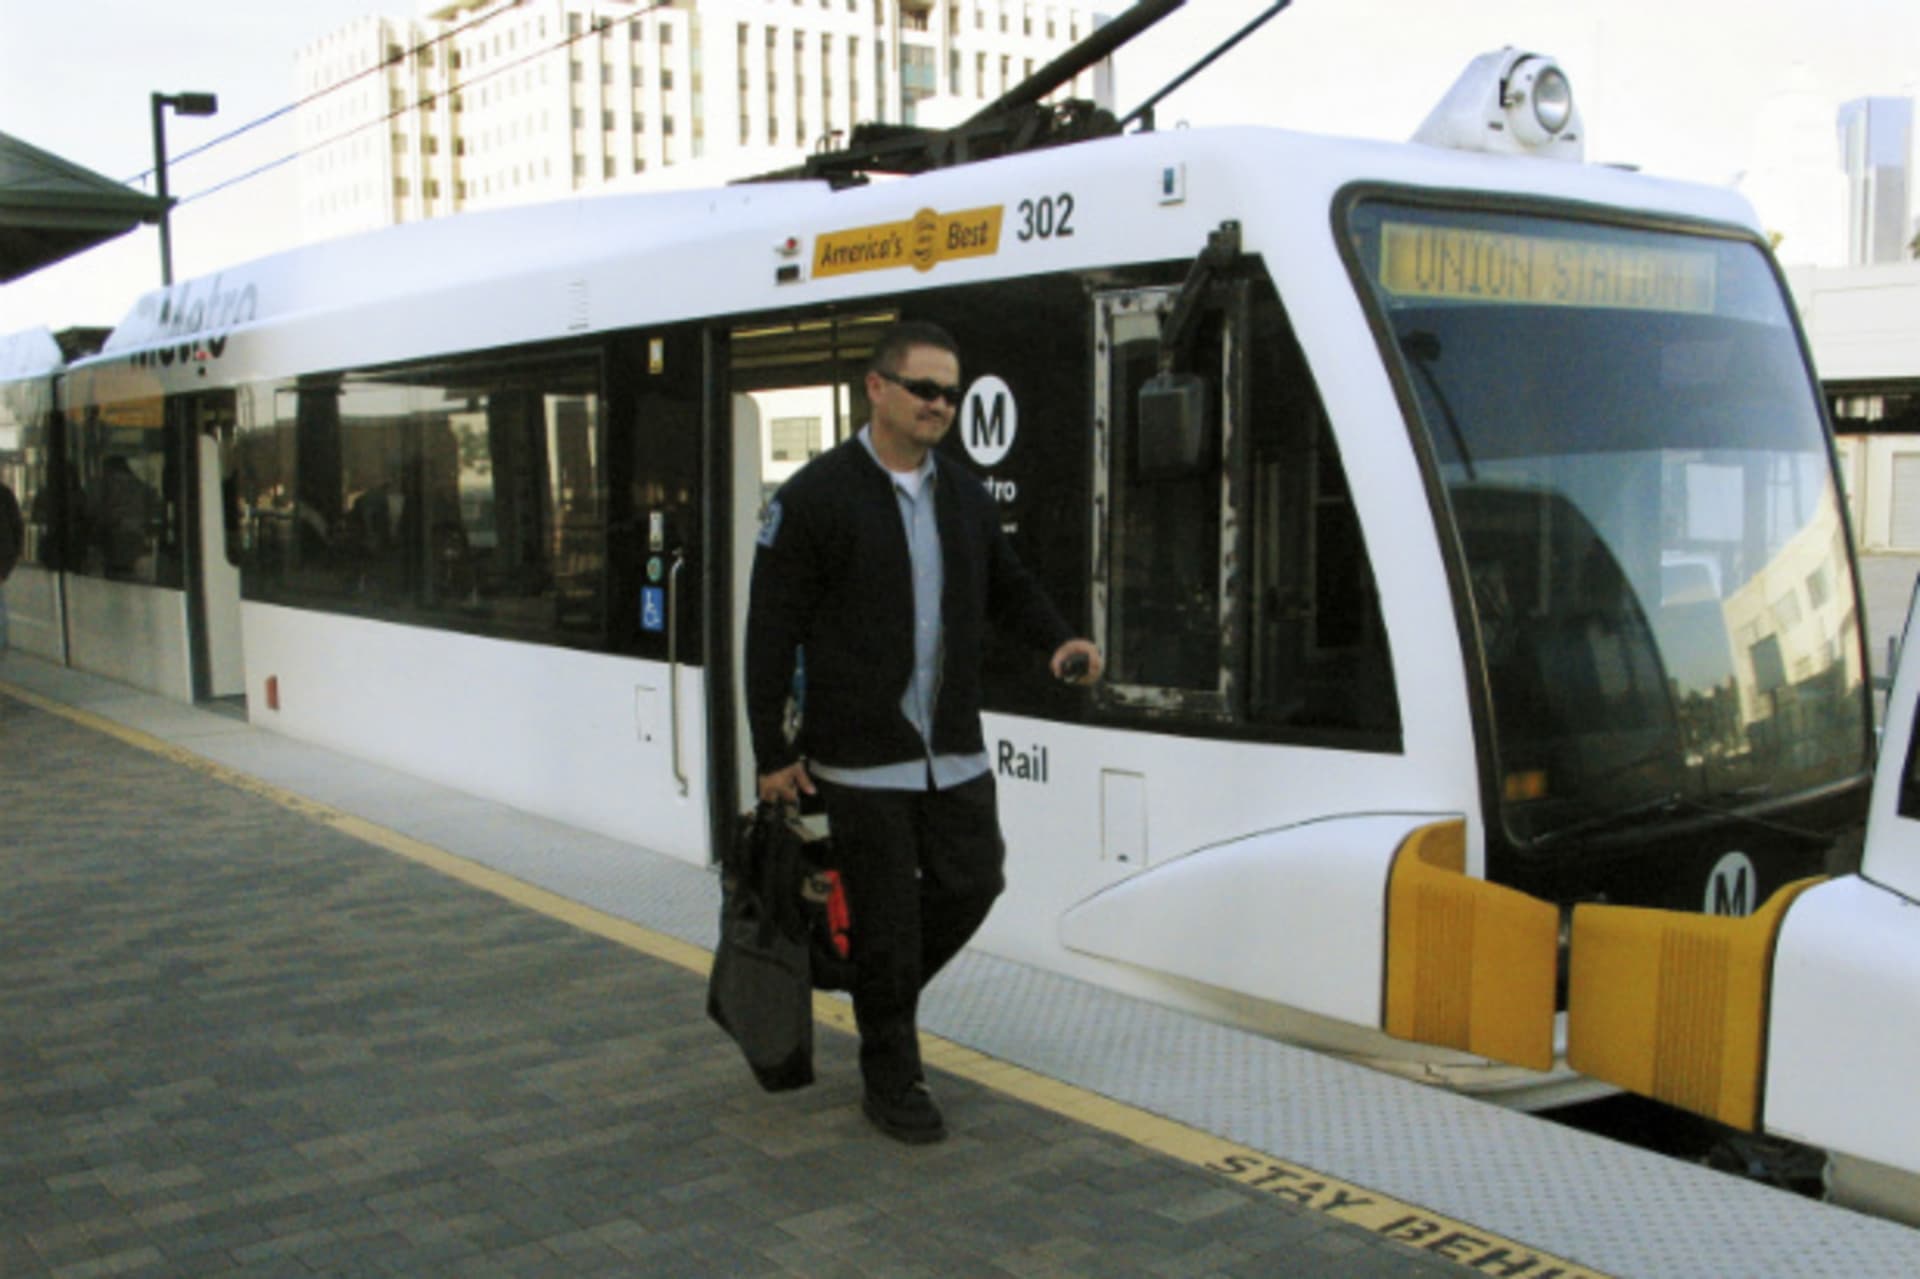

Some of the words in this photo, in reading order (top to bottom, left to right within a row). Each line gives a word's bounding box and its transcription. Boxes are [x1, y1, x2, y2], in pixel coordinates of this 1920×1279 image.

[1016, 191, 1075, 243] 302
[820, 230, 904, 268] America's
[946, 220, 989, 251] Best
[1415, 229, 1535, 297] UNION
[997, 739, 1049, 784] Rail
[1205, 1154, 1374, 1212] STAY
[1378, 1215, 1592, 1279] BEHI
